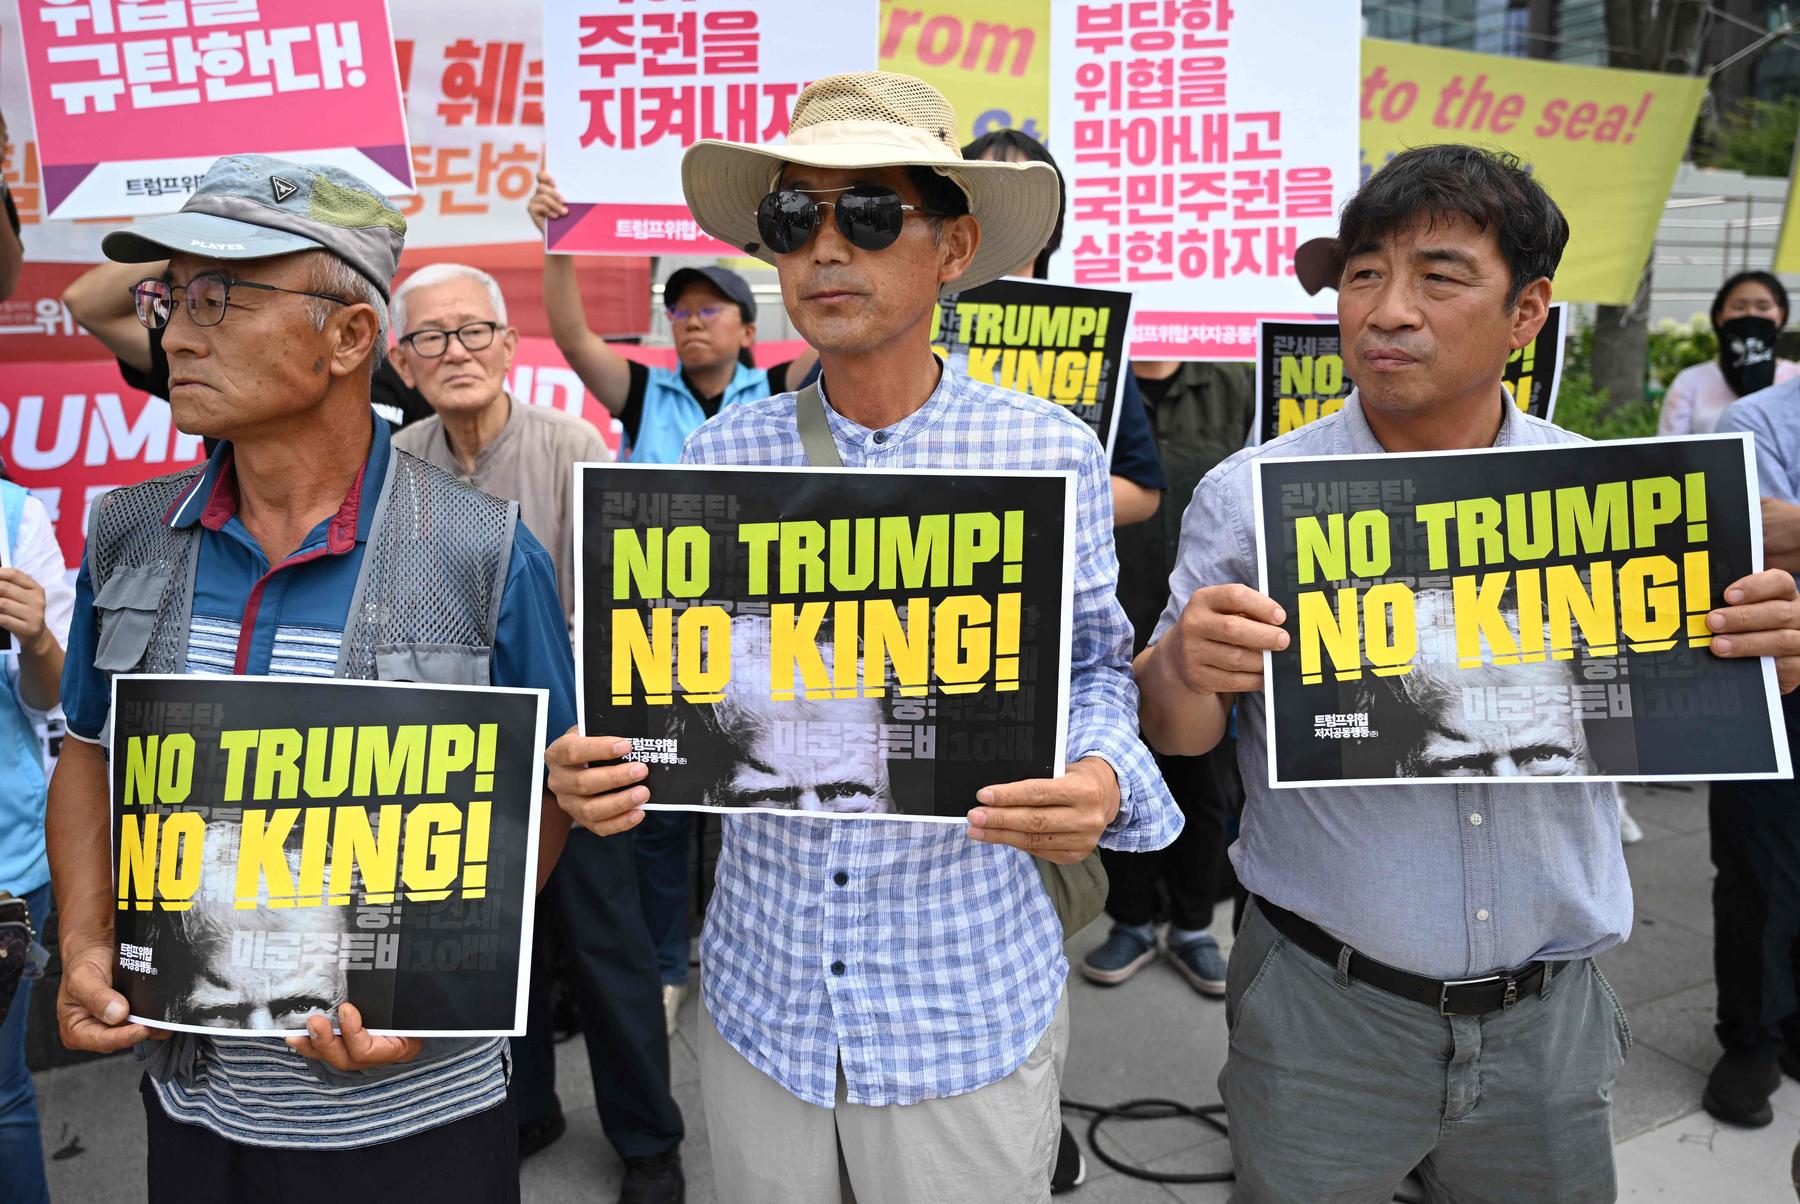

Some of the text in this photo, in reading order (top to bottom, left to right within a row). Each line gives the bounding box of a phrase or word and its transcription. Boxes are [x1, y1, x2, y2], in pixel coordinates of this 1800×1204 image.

[578, 10, 760, 78] 주권을
[880, 6, 1036, 77] rom
[1075, 0, 1234, 54] 부당한
[47, 20, 367, 115] 규탄한다!
[1074, 56, 1228, 112] 위협을
[1360, 65, 1655, 144] to the sea!
[1073, 112, 1282, 169] 막아내고
[1073, 167, 1333, 225] 국민주권을
[190, 239, 246, 251] PLAYER
[1073, 226, 1298, 284] 실현하자!
[956, 302, 1110, 348] TRUMP!
[967, 347, 1104, 405] KING!
[1280, 355, 1344, 395] NO
[613, 510, 1024, 600] NO TRUMP!
[1295, 509, 1392, 584] NO
[1415, 471, 1709, 571] TRUMP!
[1298, 550, 1713, 685] NO KING!
[611, 592, 1022, 705] NO KING!
[1313, 712, 1369, 727] 트럼프위협
[123, 723, 498, 806] NO TRUMP!
[118, 801, 492, 911] NO KING!
[120, 943, 153, 961] 트럼프위협
